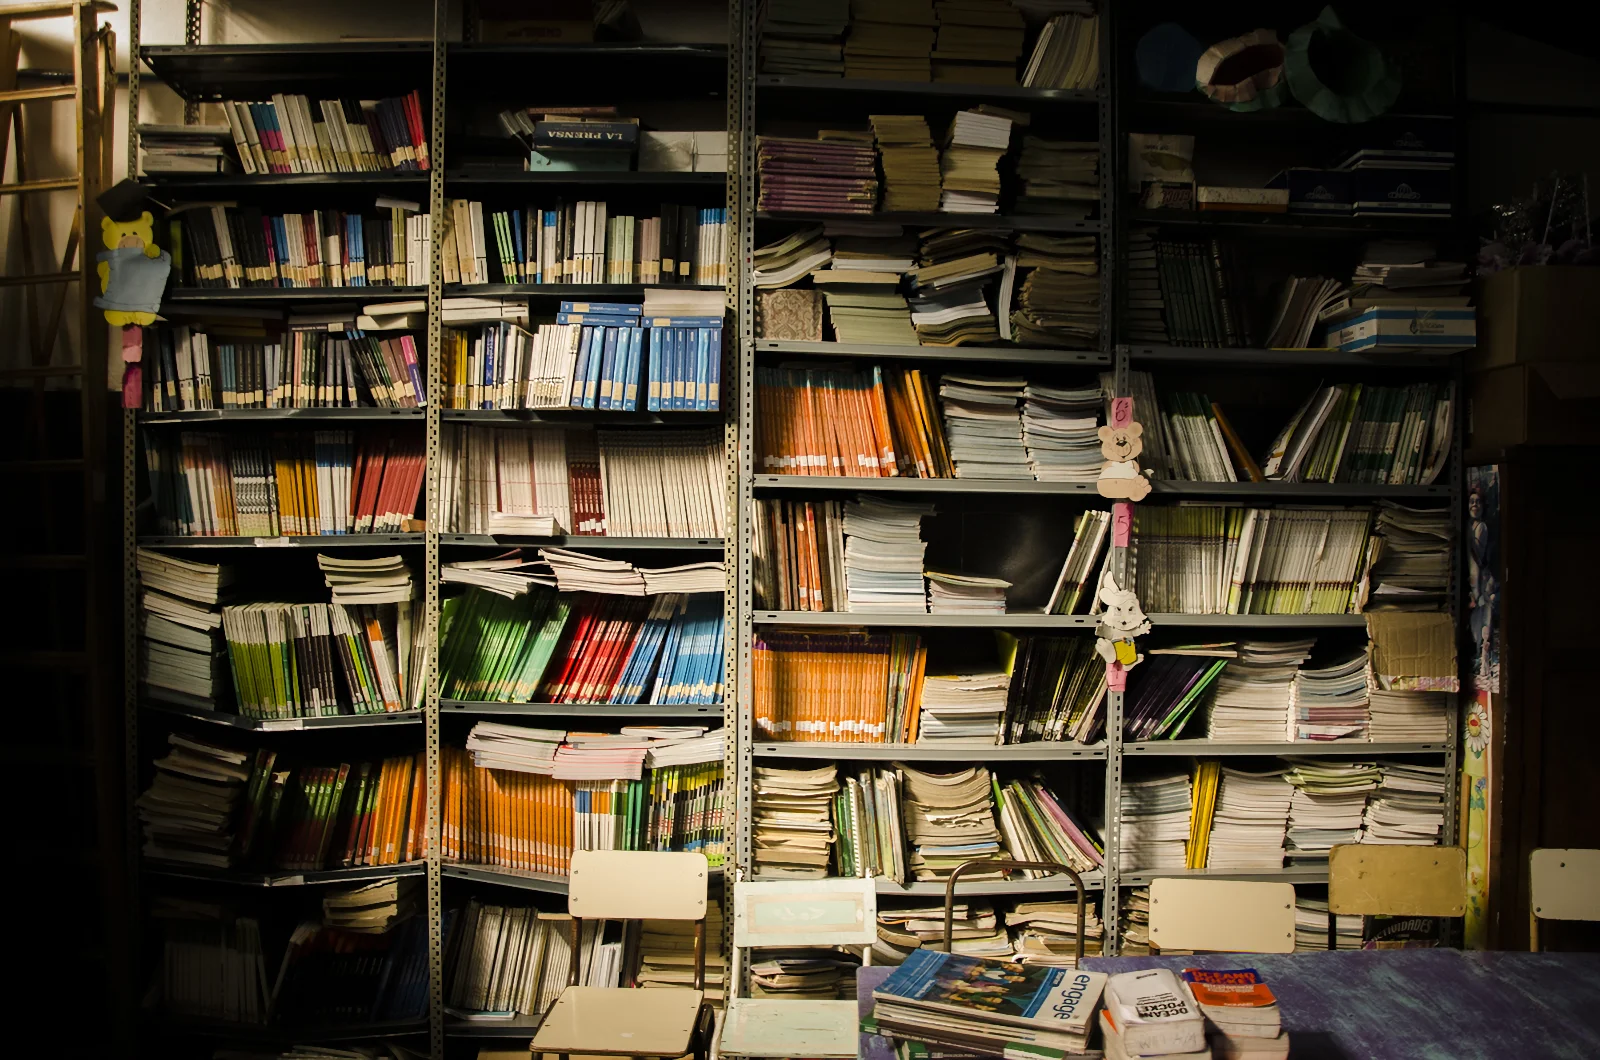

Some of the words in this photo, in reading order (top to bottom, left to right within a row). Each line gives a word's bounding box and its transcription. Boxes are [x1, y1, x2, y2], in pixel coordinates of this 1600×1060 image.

[547, 131, 602, 139] PRENSA
[606, 132, 623, 140] LA
[1053, 974, 1091, 1020] engage
